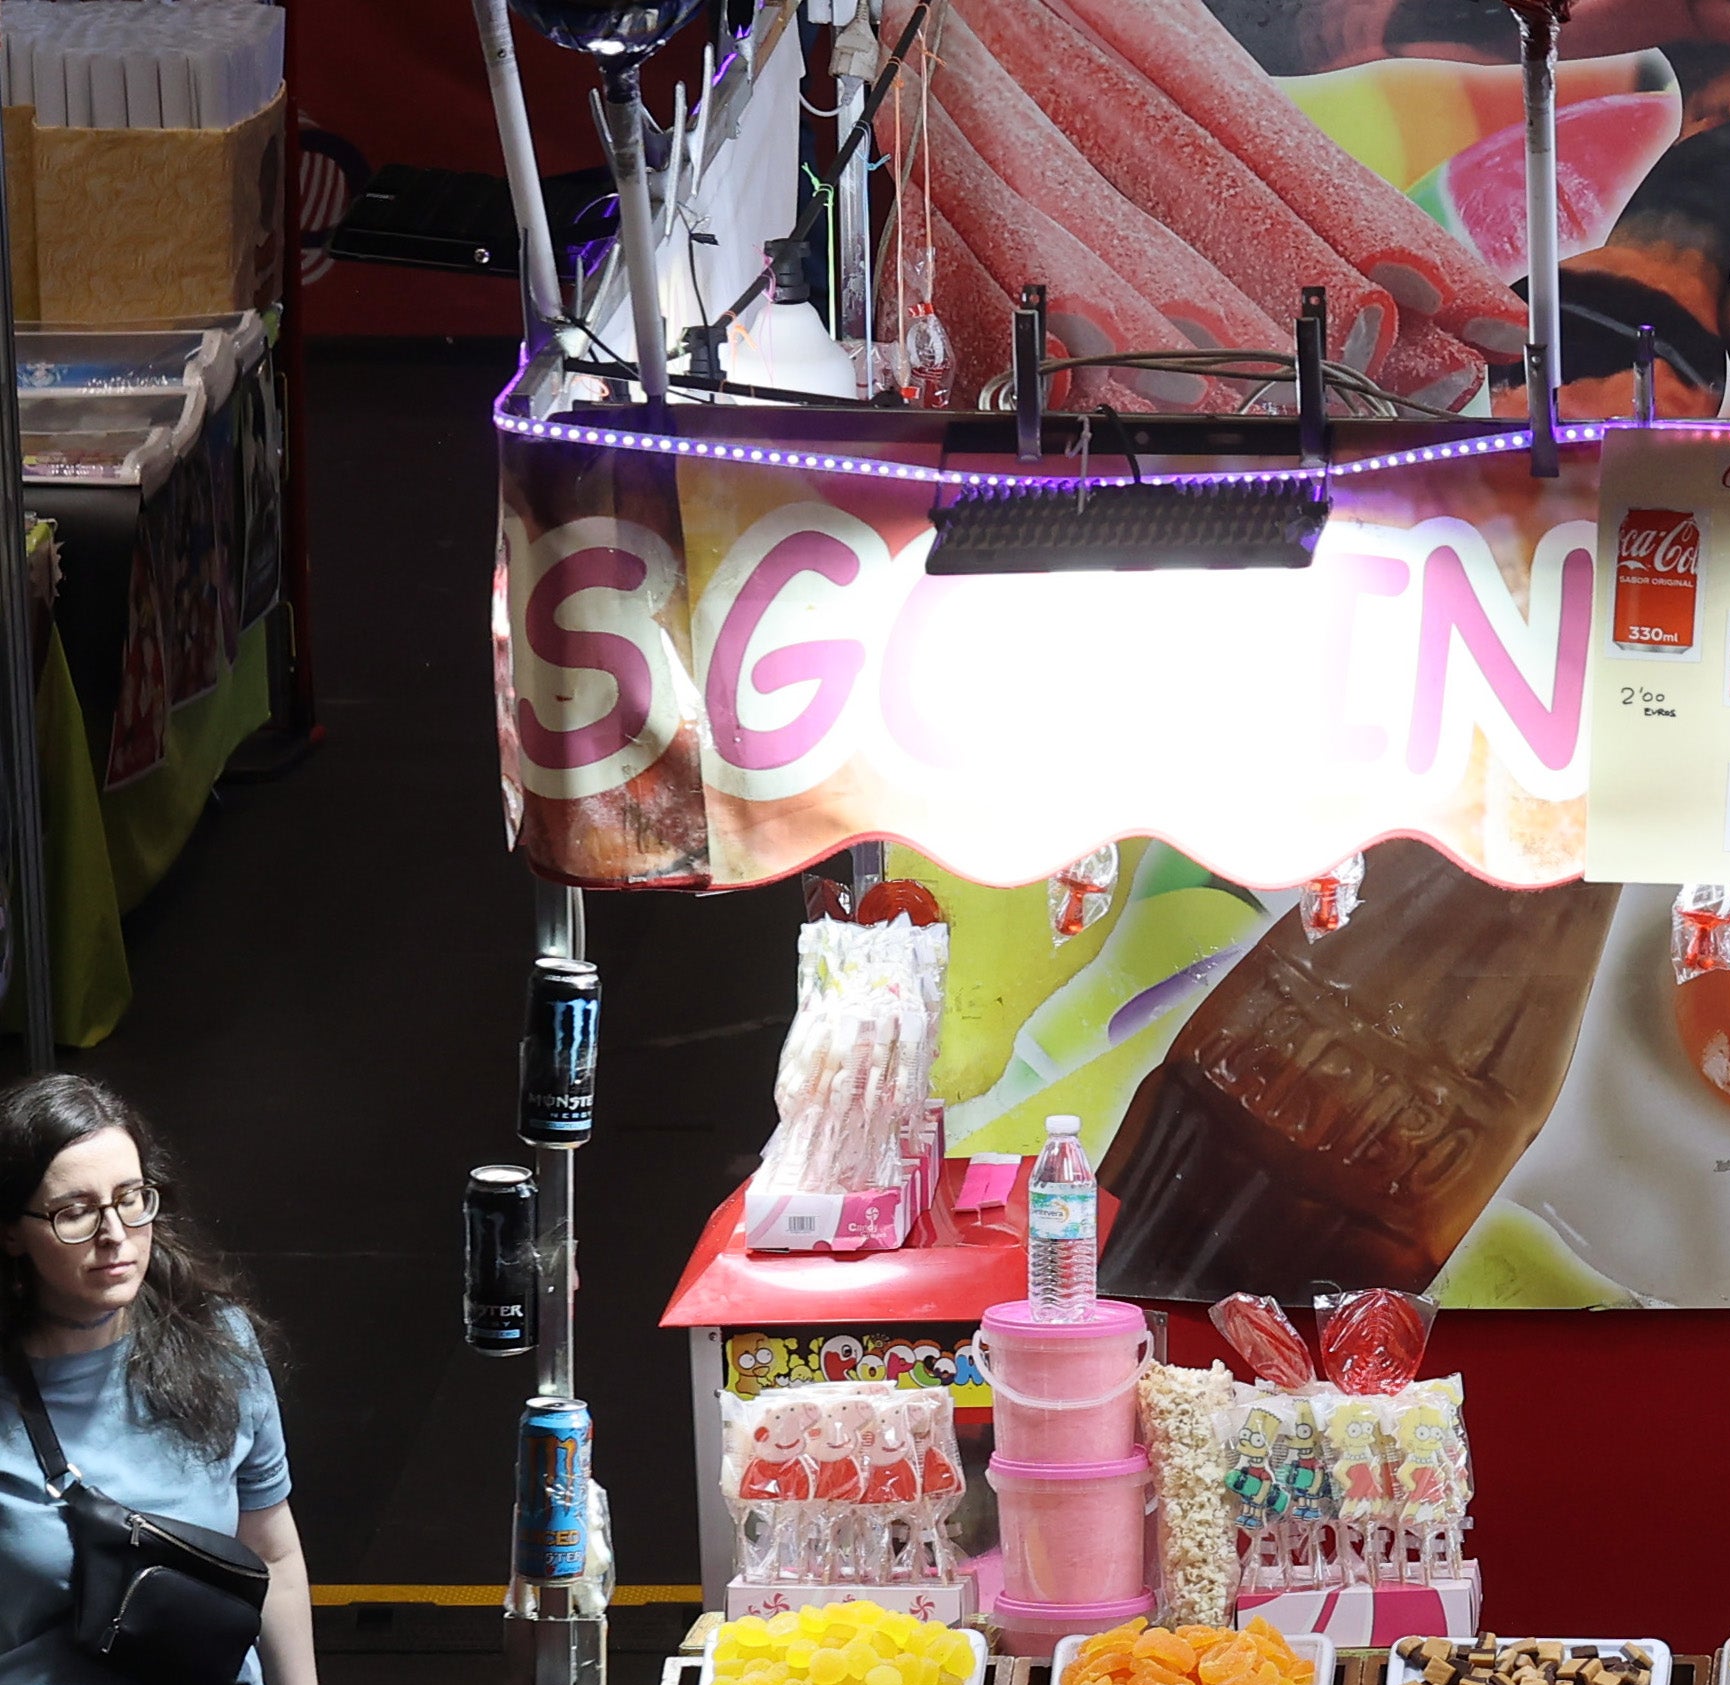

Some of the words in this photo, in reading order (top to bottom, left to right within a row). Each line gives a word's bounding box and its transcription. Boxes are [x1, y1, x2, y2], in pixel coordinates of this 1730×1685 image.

[1620, 575, 1650, 585] SABOR
[1651, 576, 1694, 588] ORIGINAL
[1628, 626, 1679, 643] 330ml
[1644, 707, 1677, 718] EUROS
